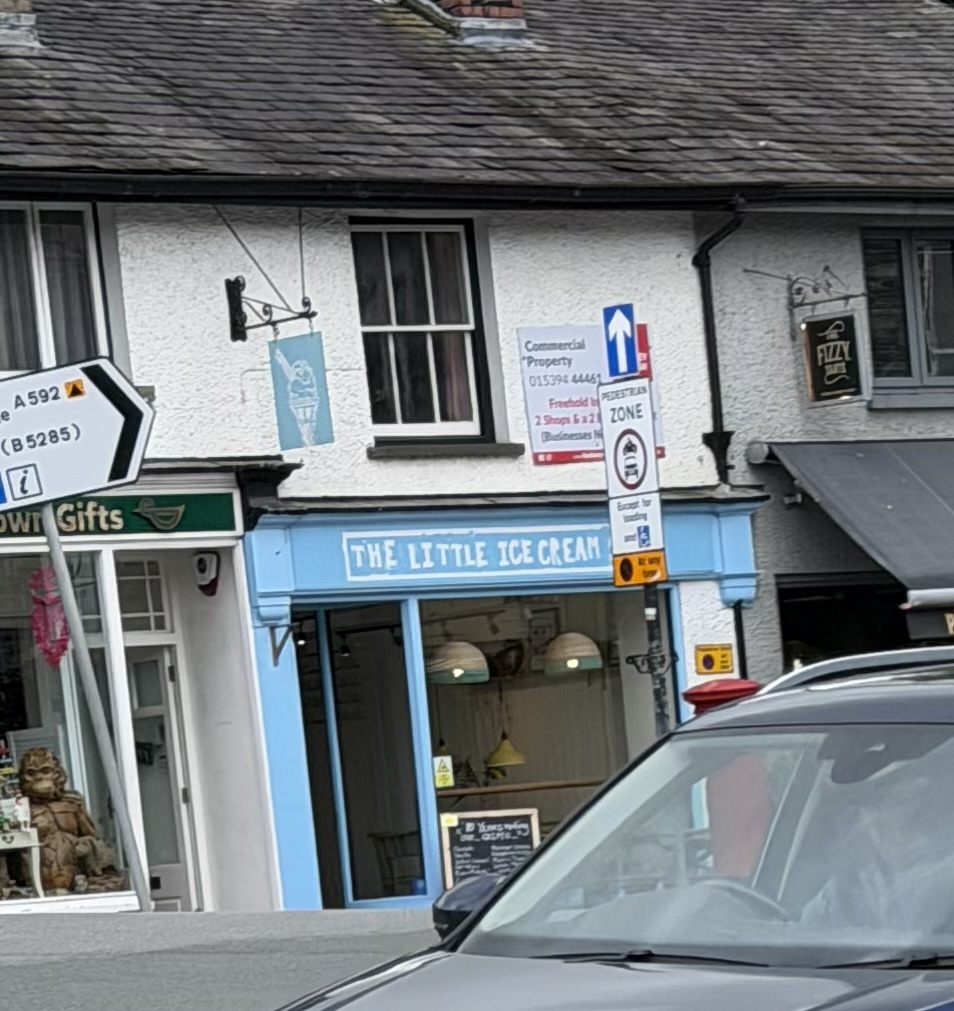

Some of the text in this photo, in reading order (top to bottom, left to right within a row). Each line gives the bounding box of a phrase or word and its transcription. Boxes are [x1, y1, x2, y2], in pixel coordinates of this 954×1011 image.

[524, 338, 586, 352] Commercial
[816, 341, 852, 367] FIZZY
[526, 355, 573, 368] Property
[601, 386, 648, 401] PEDESTRIAN
[610, 403, 644, 423] ZONE
[56, 501, 125, 532] Gifts
[350, 536, 600, 569] THE LITTLE ICE CREAM
